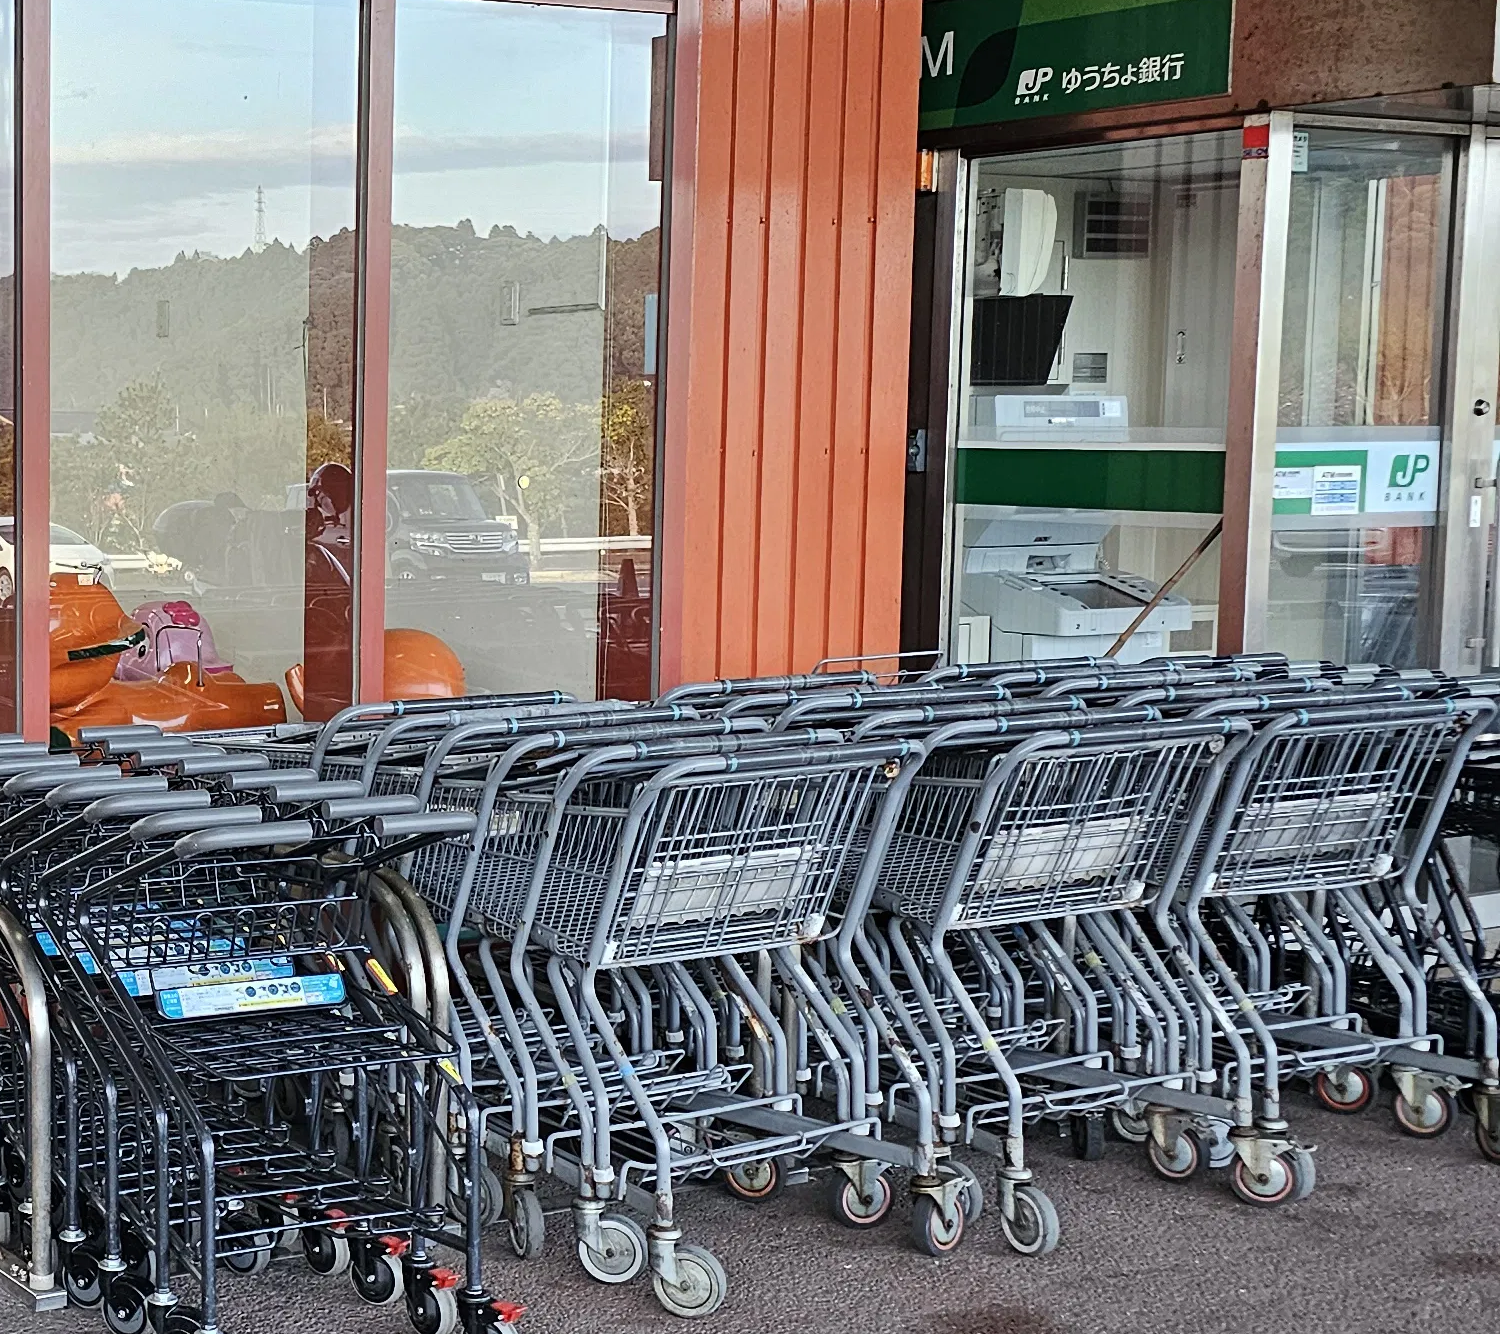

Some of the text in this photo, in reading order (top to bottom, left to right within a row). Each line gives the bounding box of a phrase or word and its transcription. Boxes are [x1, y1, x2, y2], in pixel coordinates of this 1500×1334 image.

[919, 30, 955, 79] M
[1061, 52, 1185, 94] ゆうちょ銀行
[1014, 93, 1050, 105] BANK
[1384, 490, 1426, 503] BANK
